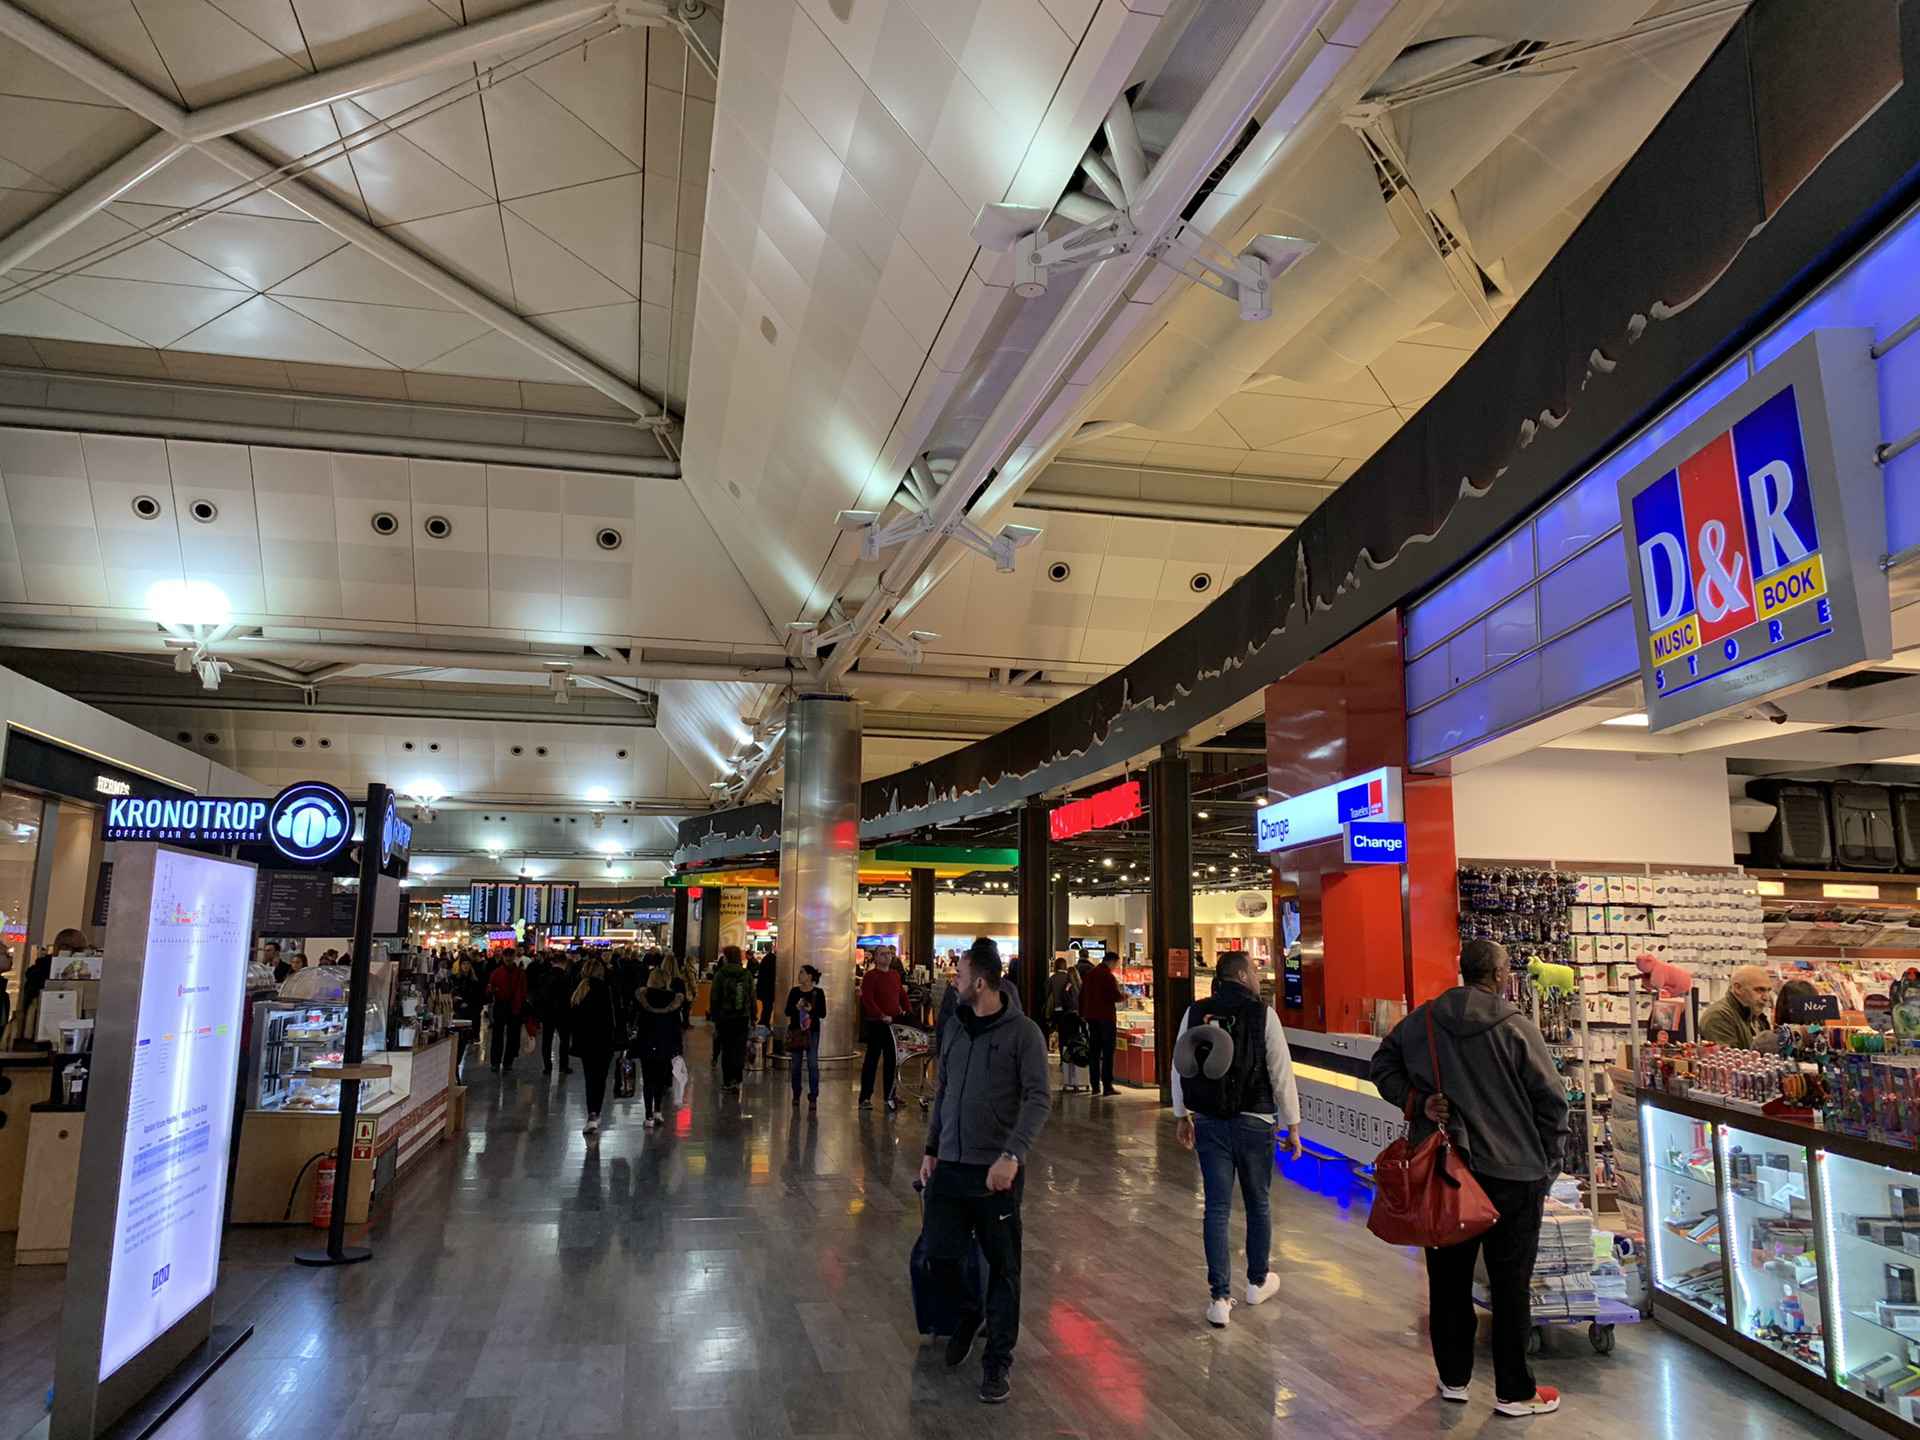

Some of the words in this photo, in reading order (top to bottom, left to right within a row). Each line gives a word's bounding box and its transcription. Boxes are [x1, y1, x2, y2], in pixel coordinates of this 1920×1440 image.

[1639, 459, 1808, 632] D&R
[1763, 567, 1815, 610] BOOK
[1654, 623, 1694, 659] MUSIC
[1655, 598, 1832, 689] STORE
[108, 798, 266, 830] KRONOTROP
[1260, 818, 1290, 842] Change
[107, 829, 151, 838] COFFEE
[159, 830, 182, 839] BAR
[189, 831, 197, 839] &
[203, 832, 263, 841] ROASTERY
[1353, 835, 1403, 851] Change
